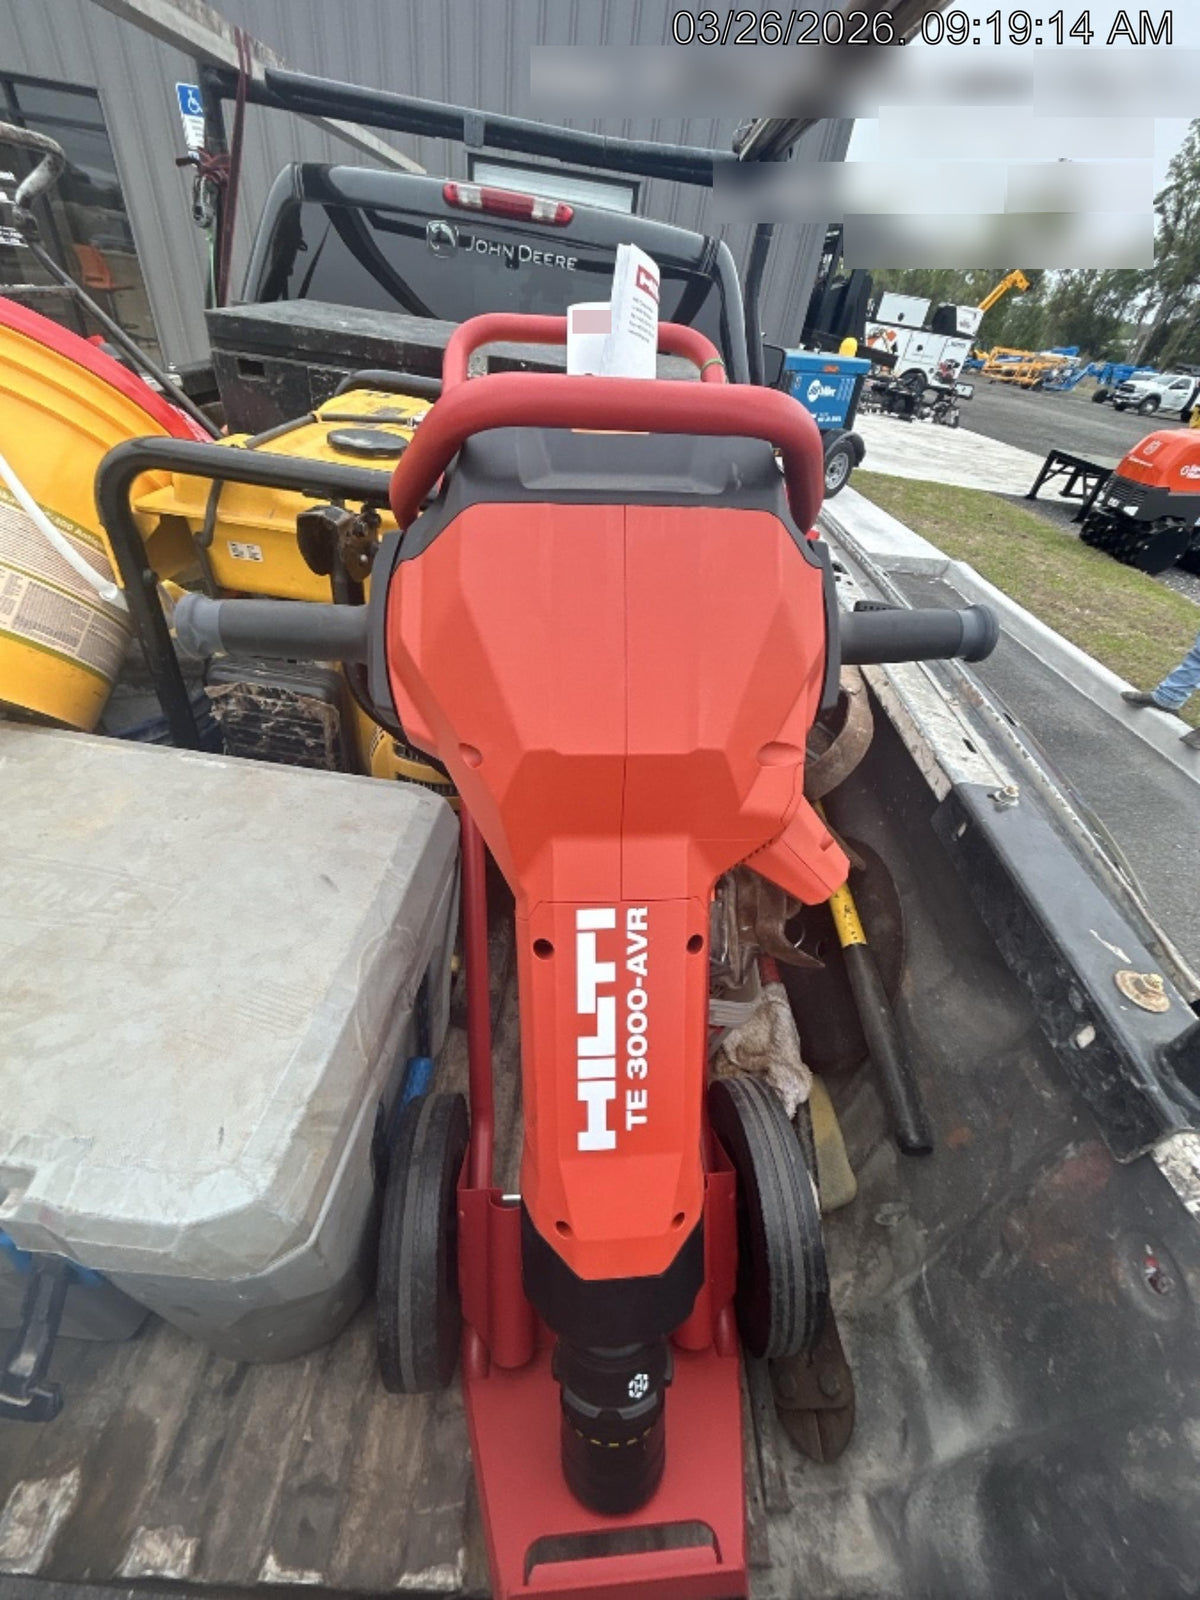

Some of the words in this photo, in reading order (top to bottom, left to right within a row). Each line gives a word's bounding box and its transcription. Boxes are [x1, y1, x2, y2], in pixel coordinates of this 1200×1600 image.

[465, 235, 515, 260] JOHN
[518, 244, 579, 272] DEERE
[576, 907, 617, 1152] HILTI
[625, 905, 649, 1081] 3000-AVR
[625, 1089, 649, 1132] TE
